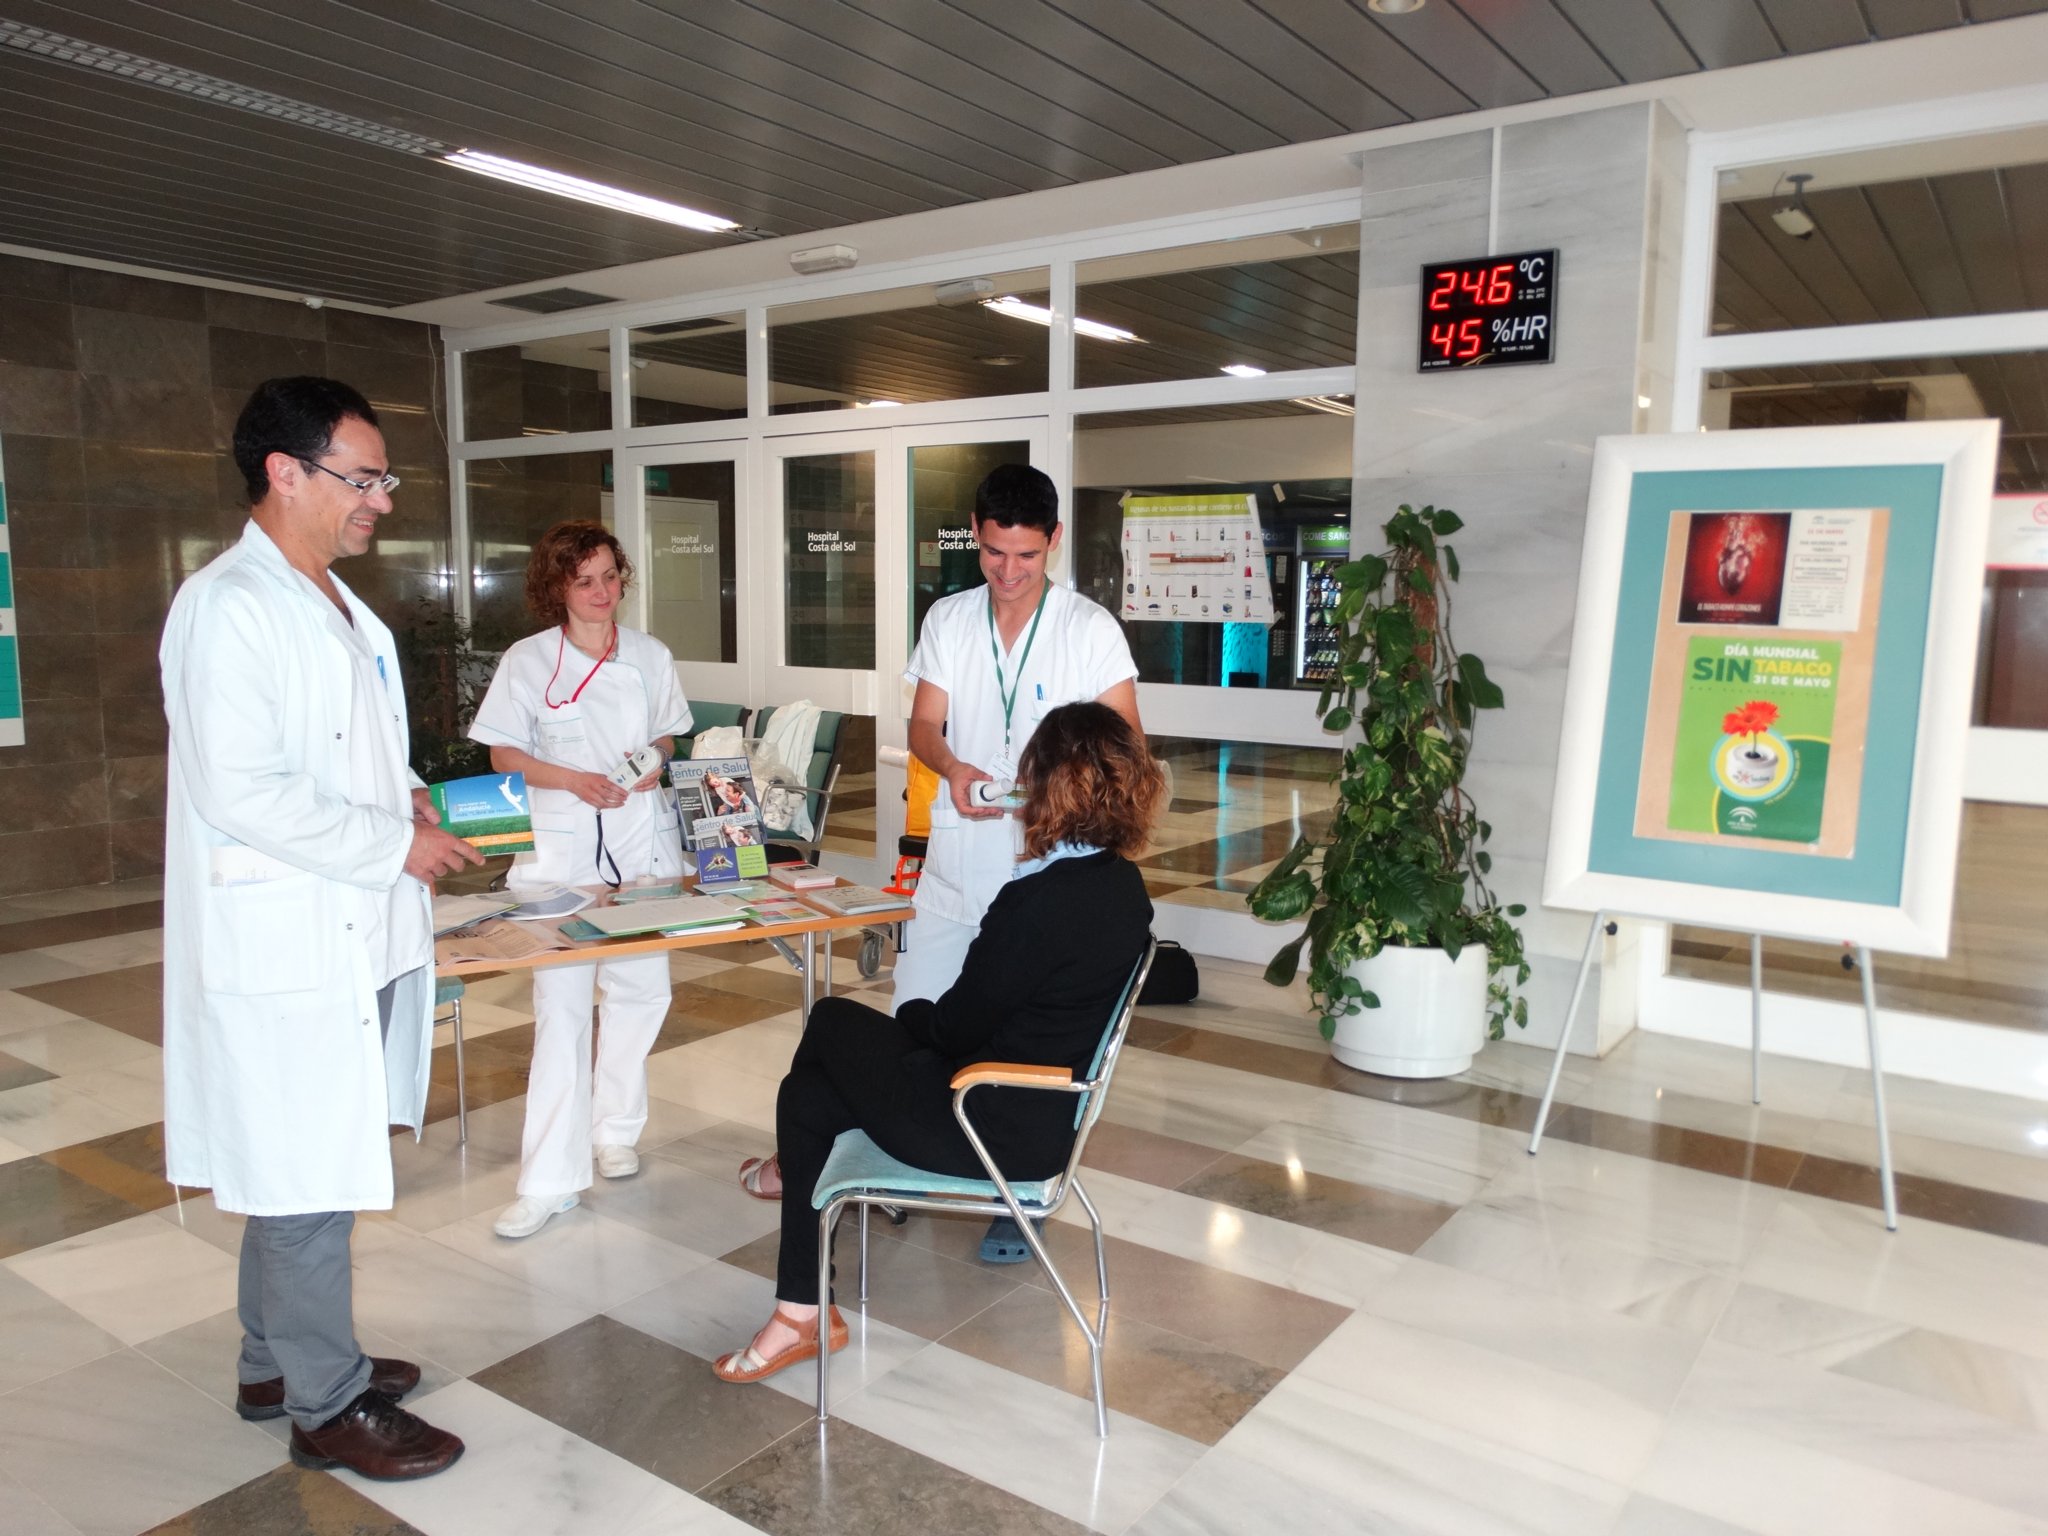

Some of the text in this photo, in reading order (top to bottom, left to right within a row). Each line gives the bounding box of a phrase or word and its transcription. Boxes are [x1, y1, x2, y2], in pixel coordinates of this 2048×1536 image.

[1430, 265, 1514, 310] 24.6
[1431, 315, 1547, 356] 45 %HR
[671, 534, 699, 548] Hospital
[807, 531, 840, 545] Hospital
[938, 527, 974, 541] Hospita
[1303, 532, 1326, 541] COME
[671, 543, 714, 554] Costa del Sol
[808, 541, 856, 552] Costa del Sol
[938, 540, 964, 550] Costa
[1724, 643, 1819, 660] DÍA MUNDIAL
[1692, 656, 1832, 683] SIN TABACO
[1753, 675, 1831, 688] 31 DE MAYO
